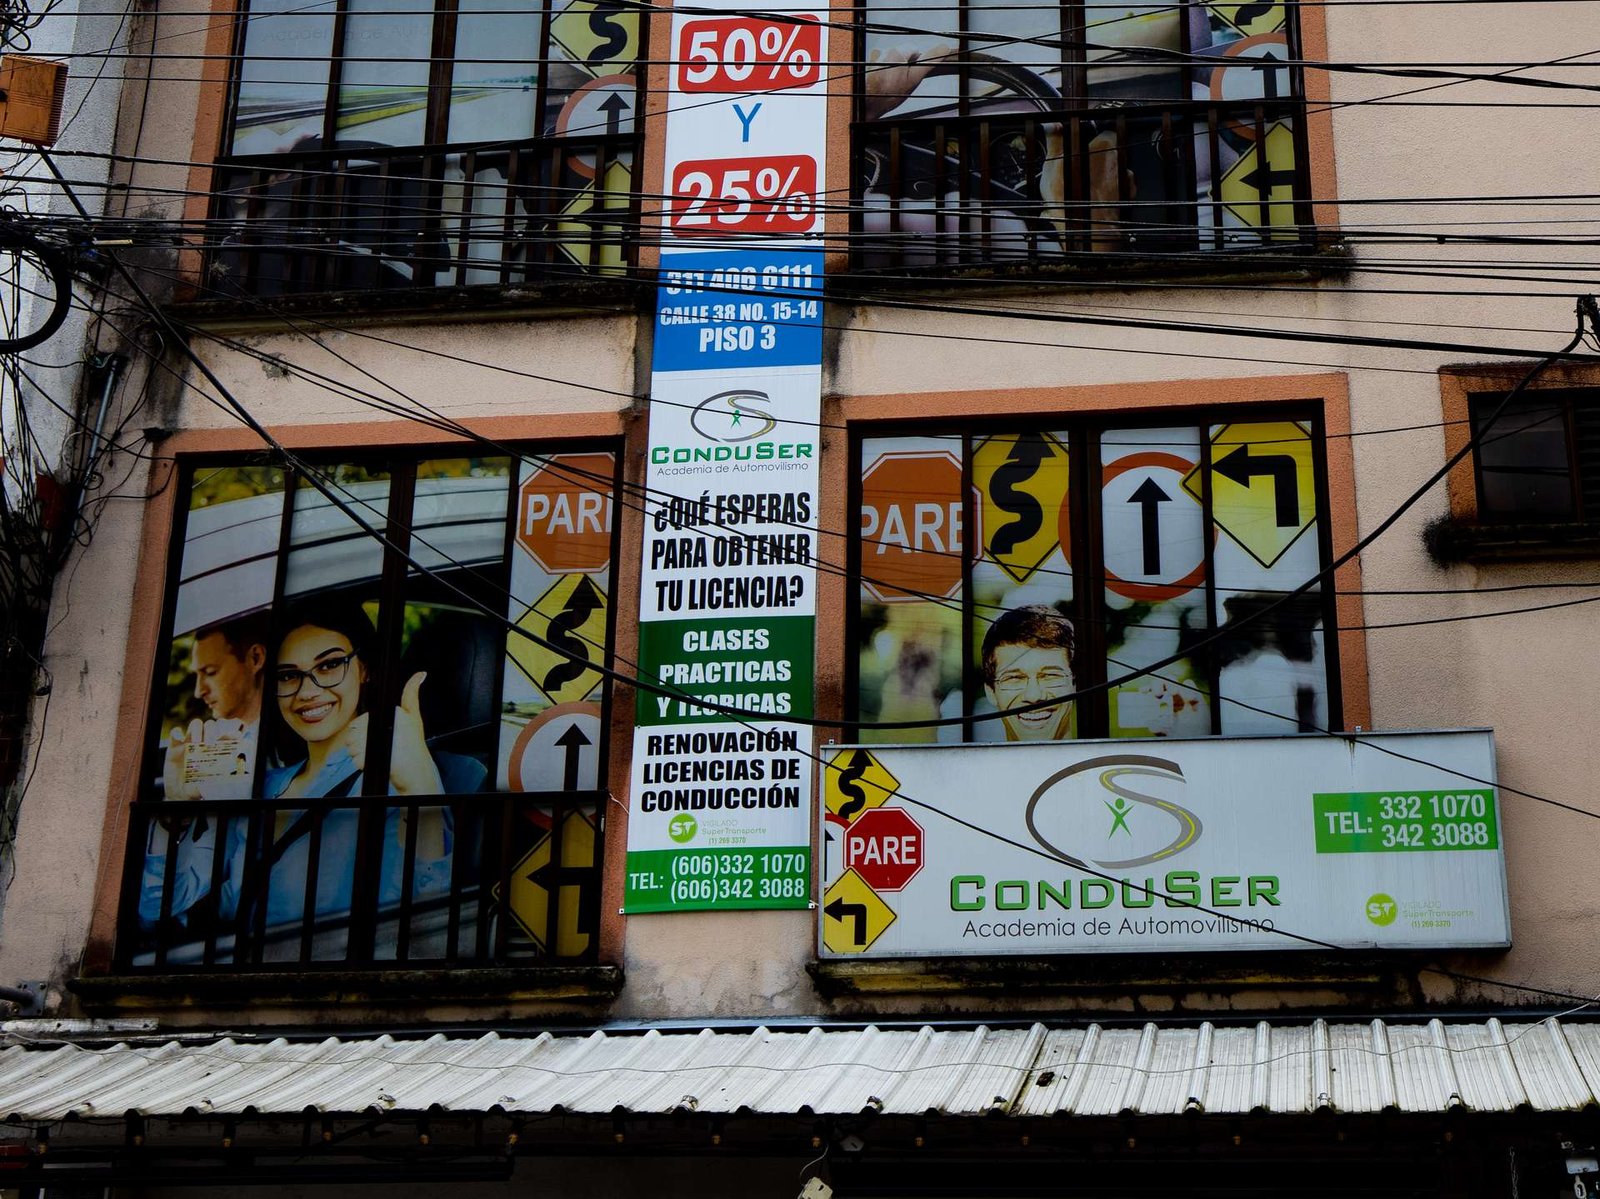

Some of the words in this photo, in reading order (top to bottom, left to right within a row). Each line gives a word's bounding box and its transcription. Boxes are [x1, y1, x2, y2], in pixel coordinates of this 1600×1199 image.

[686, 25, 812, 84] 50%
[732, 102, 762, 142] Y
[676, 166, 811, 225] 25%
[660, 306, 709, 325] CALLE
[712, 304, 736, 323] 38
[739, 302, 768, 321] NO.
[771, 300, 818, 320] 15-14
[699, 326, 755, 353] PISO
[760, 324, 776, 350] 3
[657, 464, 712, 476] Academia
[716, 463, 730, 474] de
[732, 461, 809, 473] Automovilismo
[715, 491, 811, 526] ESPERAS
[651, 537, 708, 570] PARA
[713, 533, 811, 568] OBTENER
[656, 579, 683, 612] TU
[688, 575, 804, 610] LICENCIA?
[682, 628, 770, 653] CLASES
[659, 660, 792, 686] PRACTICAS
[656, 697, 671, 718] Y
[647, 727, 798, 756] RENOVACIÓN
[643, 759, 766, 784] LICENCIAS
[771, 758, 801, 780] DE
[641, 783, 800, 813] CONDUCCIÓN
[1379, 797, 1422, 820] 332
[1429, 795, 1486, 818] 1070
[1324, 812, 1373, 834] TEL:
[1382, 824, 1425, 847] 342
[1431, 822, 1489, 846] 3088
[850, 835, 917, 866] PARE
[671, 853, 754, 880] (606)332
[761, 854, 806, 874] 1070
[630, 873, 665, 890] TEL:
[670, 877, 753, 903] (606)342
[760, 878, 805, 898] 3088
[962, 917, 1076, 938] Academia
[1091, 917, 1111, 936] de
[1118, 914, 1274, 935] Automovilismo
